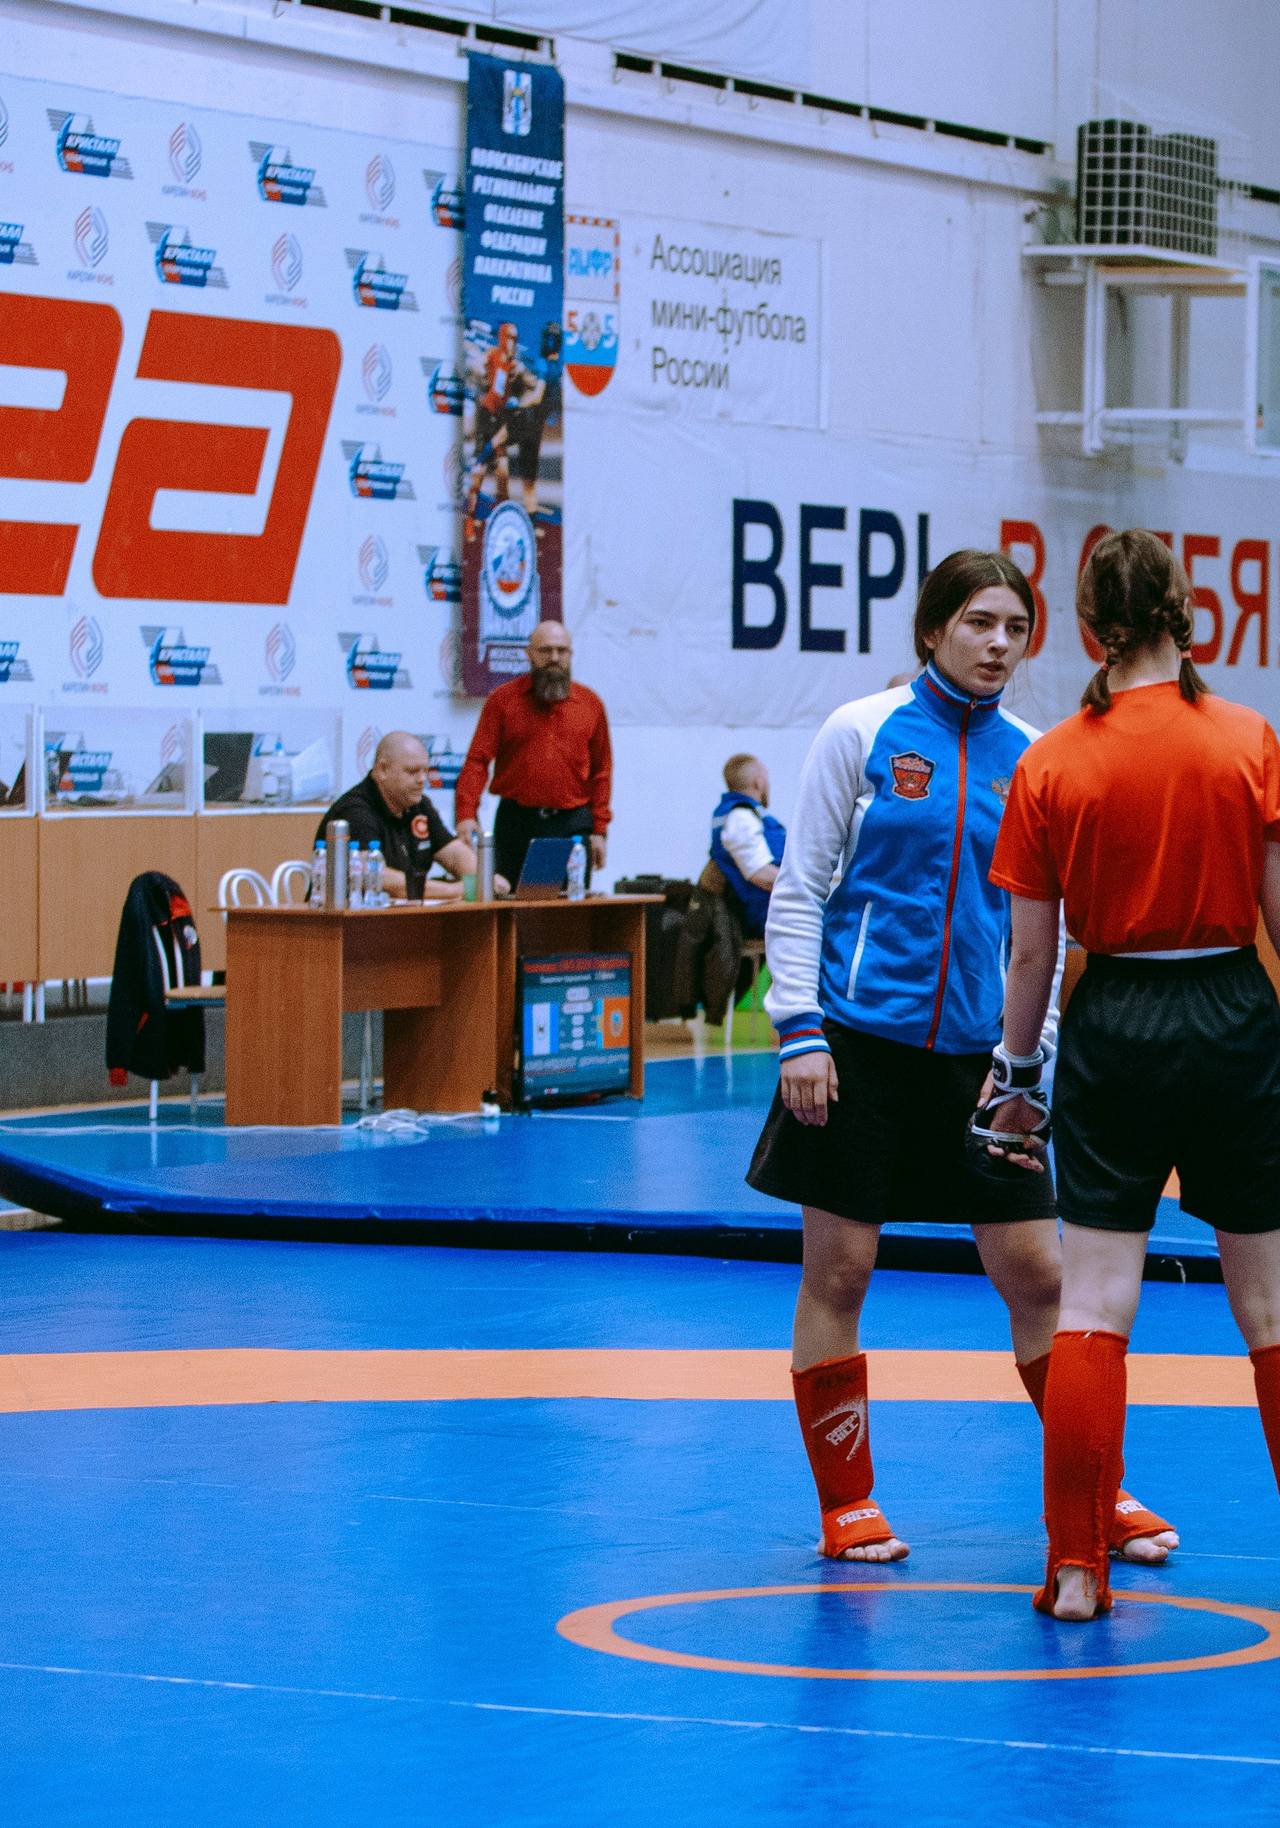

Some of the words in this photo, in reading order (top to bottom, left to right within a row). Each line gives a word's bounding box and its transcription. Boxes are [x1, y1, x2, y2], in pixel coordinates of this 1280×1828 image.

[650, 233, 782, 290] Ассоциация
[651, 299, 807, 347] мини-футбола
[651, 346, 730, 390] России
[825, 1412, 858, 1441] GREEN
[831, 1423, 859, 1446] HILL
